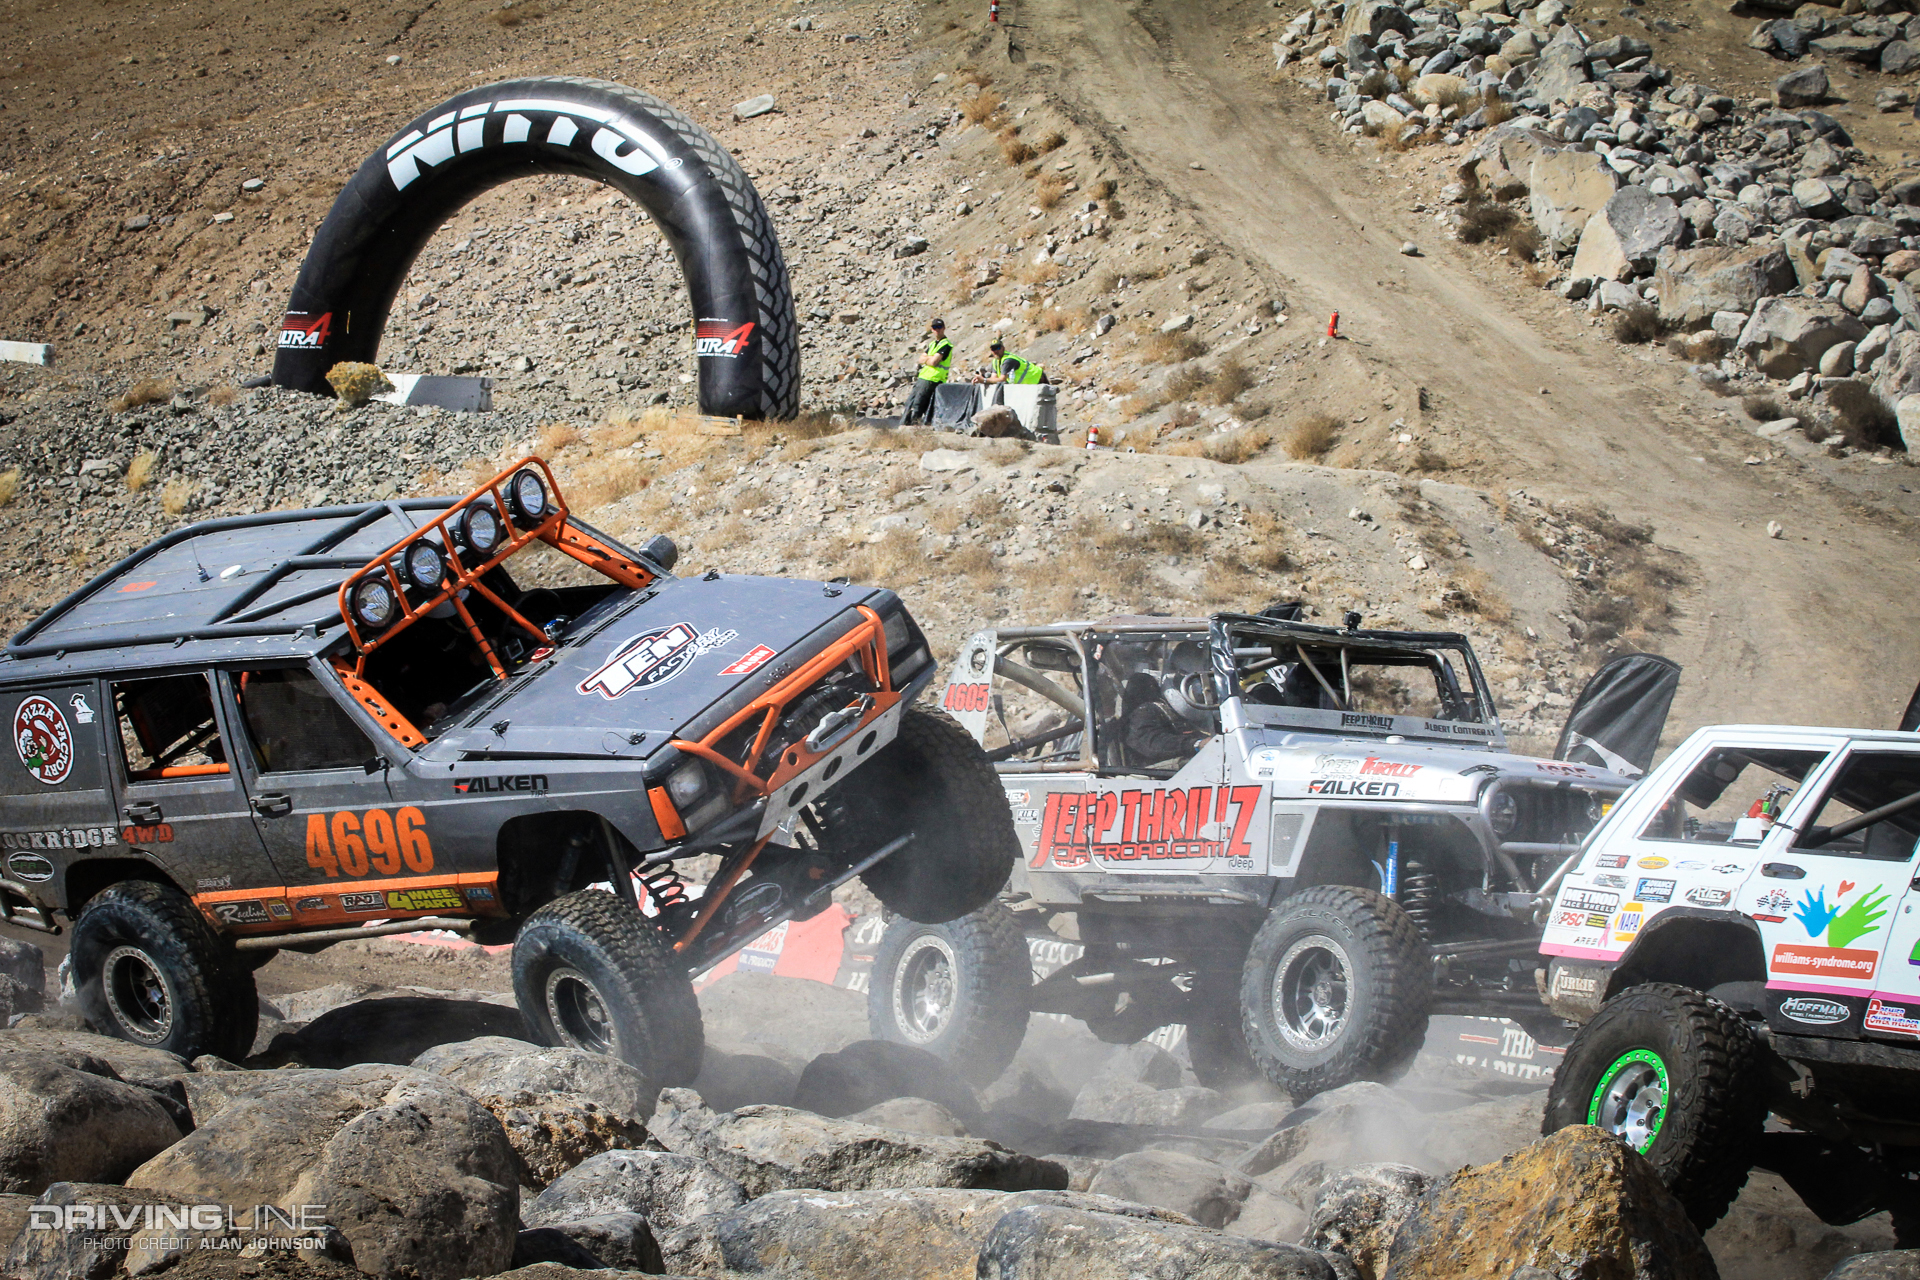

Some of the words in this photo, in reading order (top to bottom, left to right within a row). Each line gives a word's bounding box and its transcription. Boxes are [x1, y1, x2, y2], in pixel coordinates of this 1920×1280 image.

[585, 626, 690, 696] TEN
[647, 628, 718, 683] FACTORY
[732, 649, 770, 672] WARN
[943, 682, 990, 712] 4605
[21, 703, 54, 725] PIZZA
[1424, 722, 1450, 733] ALBERT
[44, 720, 69, 777] FACTORY
[1359, 756, 1424, 778] THRILLZ
[453, 774, 548, 794] FALKEN
[1307, 779, 1399, 797] FALKEN
[121, 824, 175, 845] 4WD
[306, 806, 434, 878] 4696
[1228, 855, 1254, 870] Jeep
[387, 891, 416, 910] 4
[405, 887, 460, 900] WHEEL
[412, 897, 463, 909] PARTS
[1562, 900, 1581, 909] RACE
[1583, 902, 1616, 913] WHEELS
[1563, 889, 1619, 907] METHOD
[215, 904, 267, 923] Raceline
[1559, 912, 1584, 926] PSC
[1618, 913, 1639, 931] NAPA
[1775, 951, 1873, 973] williams-syndrome.org
[1501, 1028, 1535, 1060] THE
